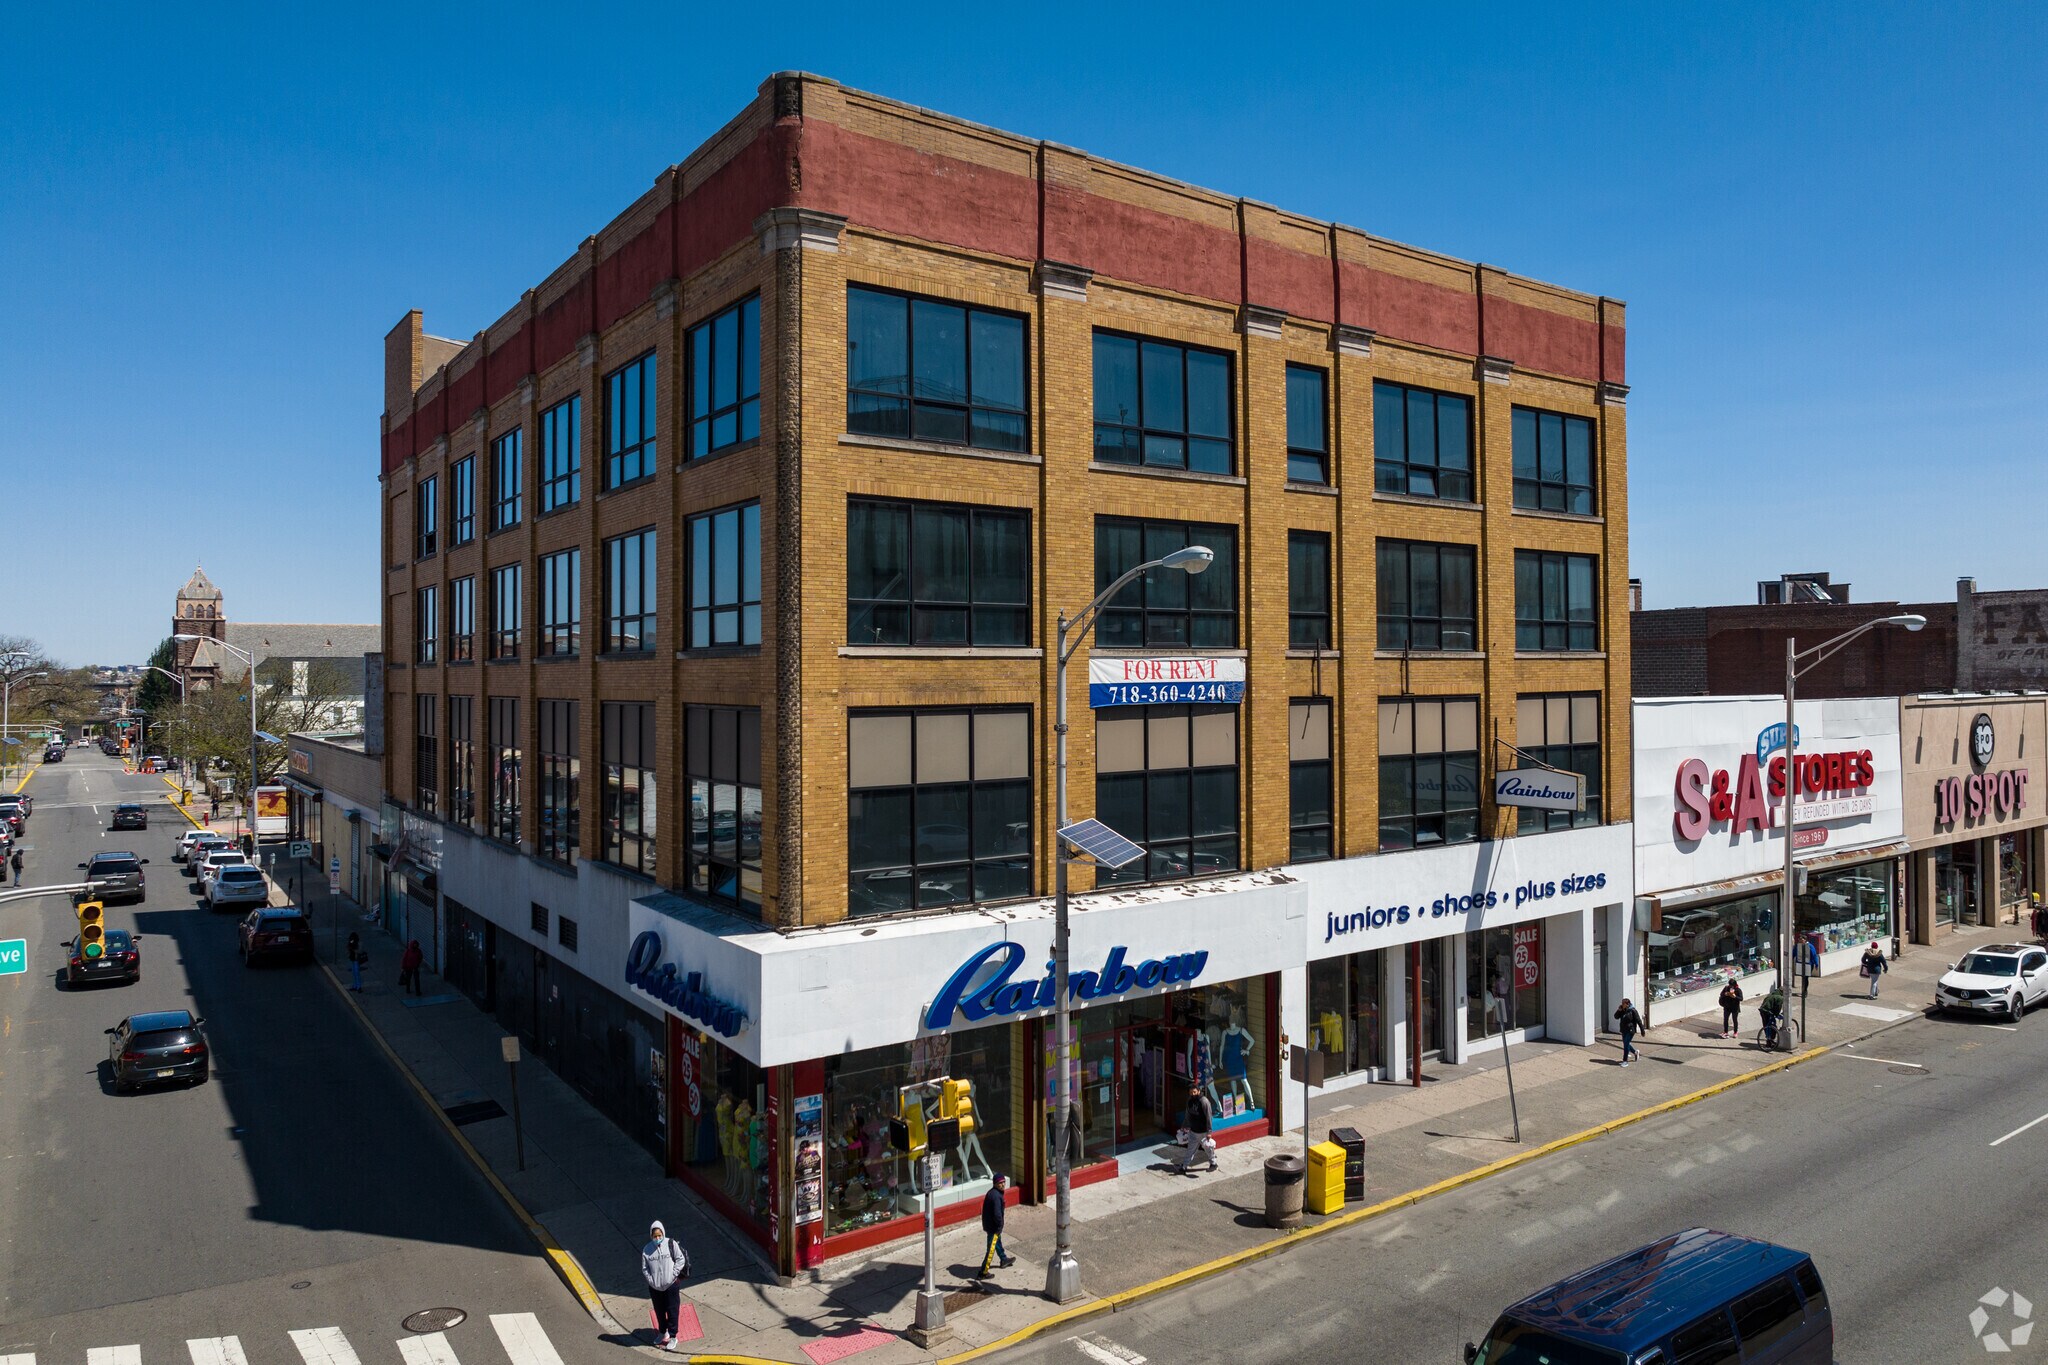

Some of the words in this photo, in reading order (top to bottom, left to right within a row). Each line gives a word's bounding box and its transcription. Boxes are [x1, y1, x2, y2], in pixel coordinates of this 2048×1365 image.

[1123, 659, 1163, 681] FOR
[1169, 659, 1218, 680] RENT
[1108, 684, 1226, 704] 718-360-4240
[1768, 749, 1874, 797] STORES
[1497, 777, 1576, 800] Rainbow
[1938, 776, 1963, 824] 10
[1967, 768, 2029, 818] SPOT
[1803, 804, 1830, 819] REFUNDED
[1832, 801, 1850, 815] WITHIN
[1851, 800, 1859, 813] 25
[1793, 834, 1810, 845] Since
[1810, 831, 1825, 842] 1961
[1325, 905, 1410, 941] juniors
[1431, 890, 1497, 917] shoes
[1515, 879, 1556, 908] plus
[1560, 872, 1606, 895] sizes
[1514, 928, 1537, 945] SALE
[0, 949, 21, 963] ve
[1516, 951, 1527, 965] 25
[1526, 966, 1536, 980] 50
[924, 940, 1209, 1030] Rainbow
[681, 1032, 700, 1059] SALE
